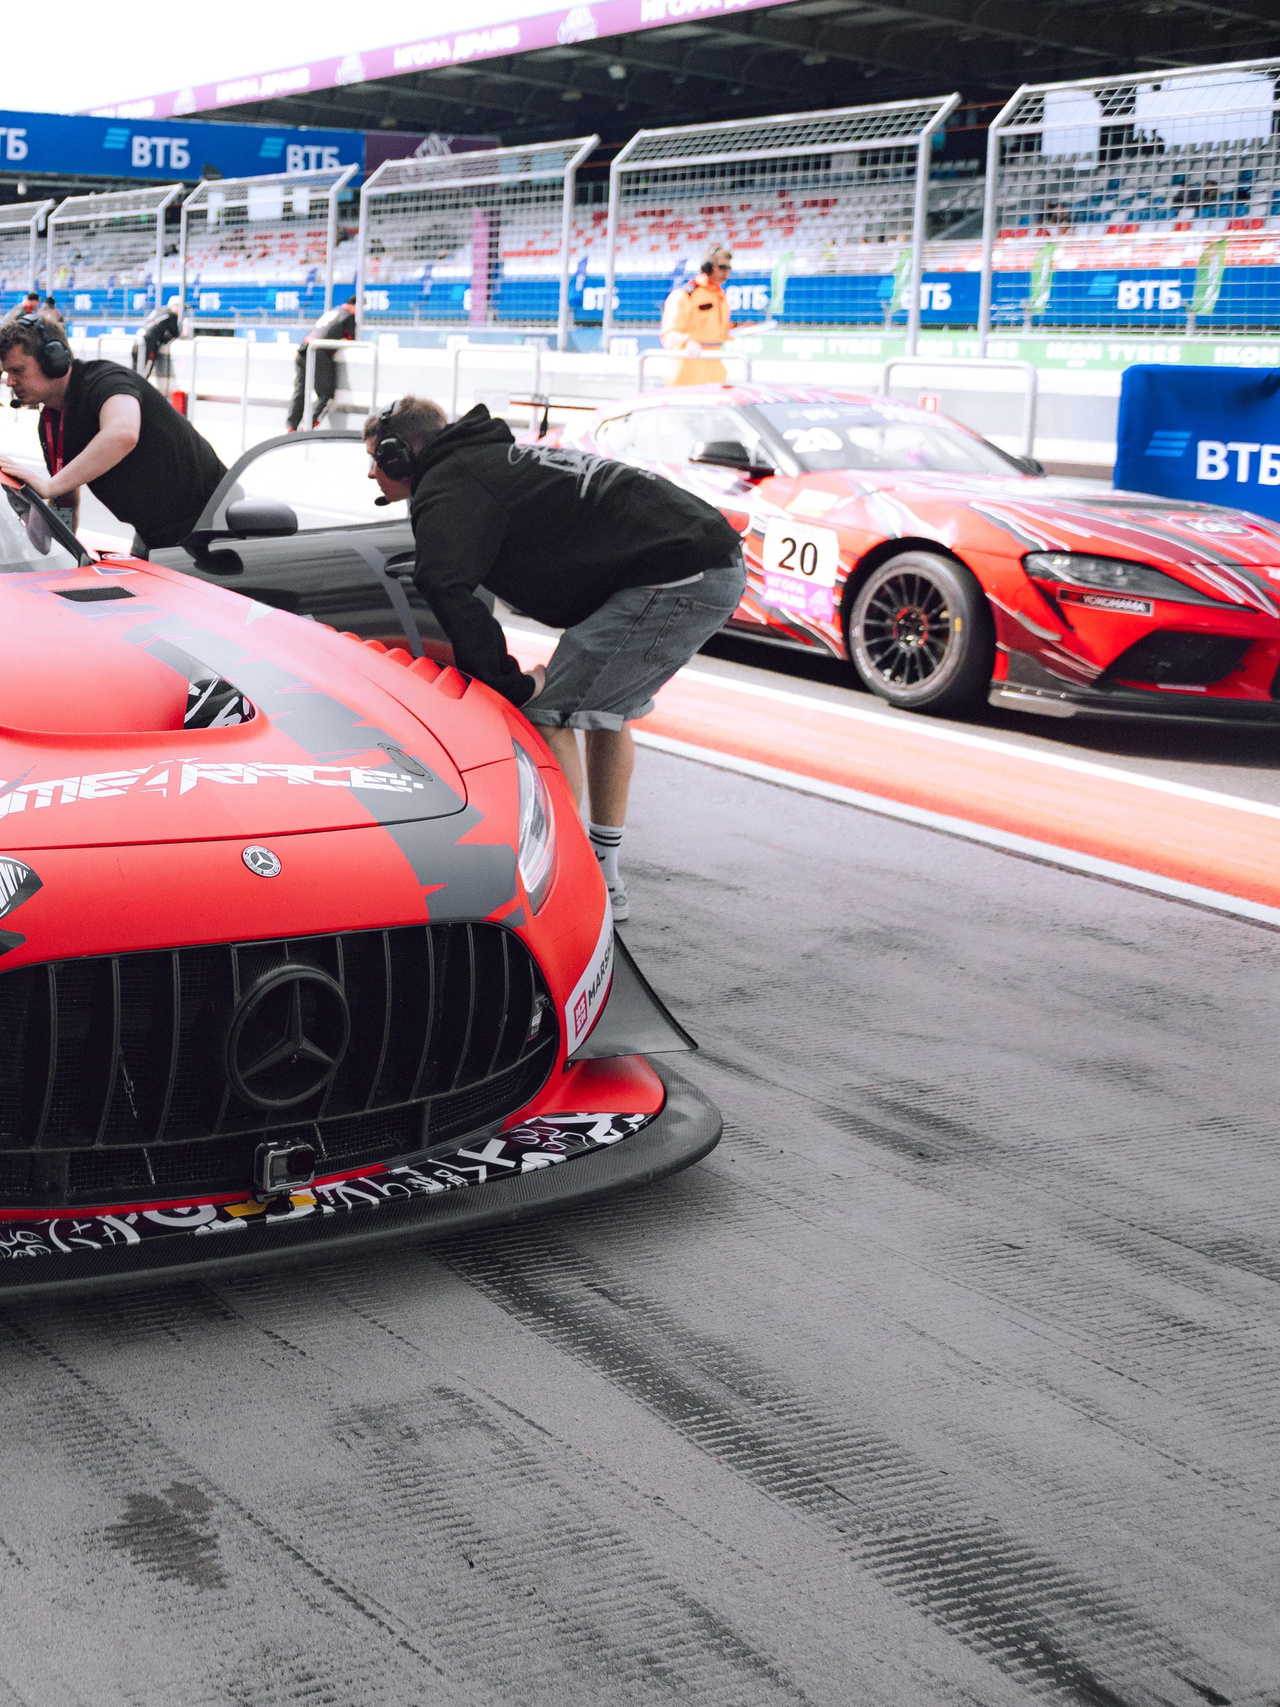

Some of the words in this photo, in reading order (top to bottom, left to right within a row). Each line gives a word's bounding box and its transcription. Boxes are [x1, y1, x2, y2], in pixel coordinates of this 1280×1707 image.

[131, 135, 191, 171] ВТБ
[286, 144, 340, 173] ВТБ
[1117, 280, 1182, 310] ВТБ
[1045, 343, 1103, 361] IKON
[1107, 343, 1181, 362] TYRES
[1214, 346, 1280, 364] IKON
[1196, 440, 1280, 486] ВТБ
[778, 537, 818, 576] 20
[1083, 594, 1147, 612] YOKOHAMA
